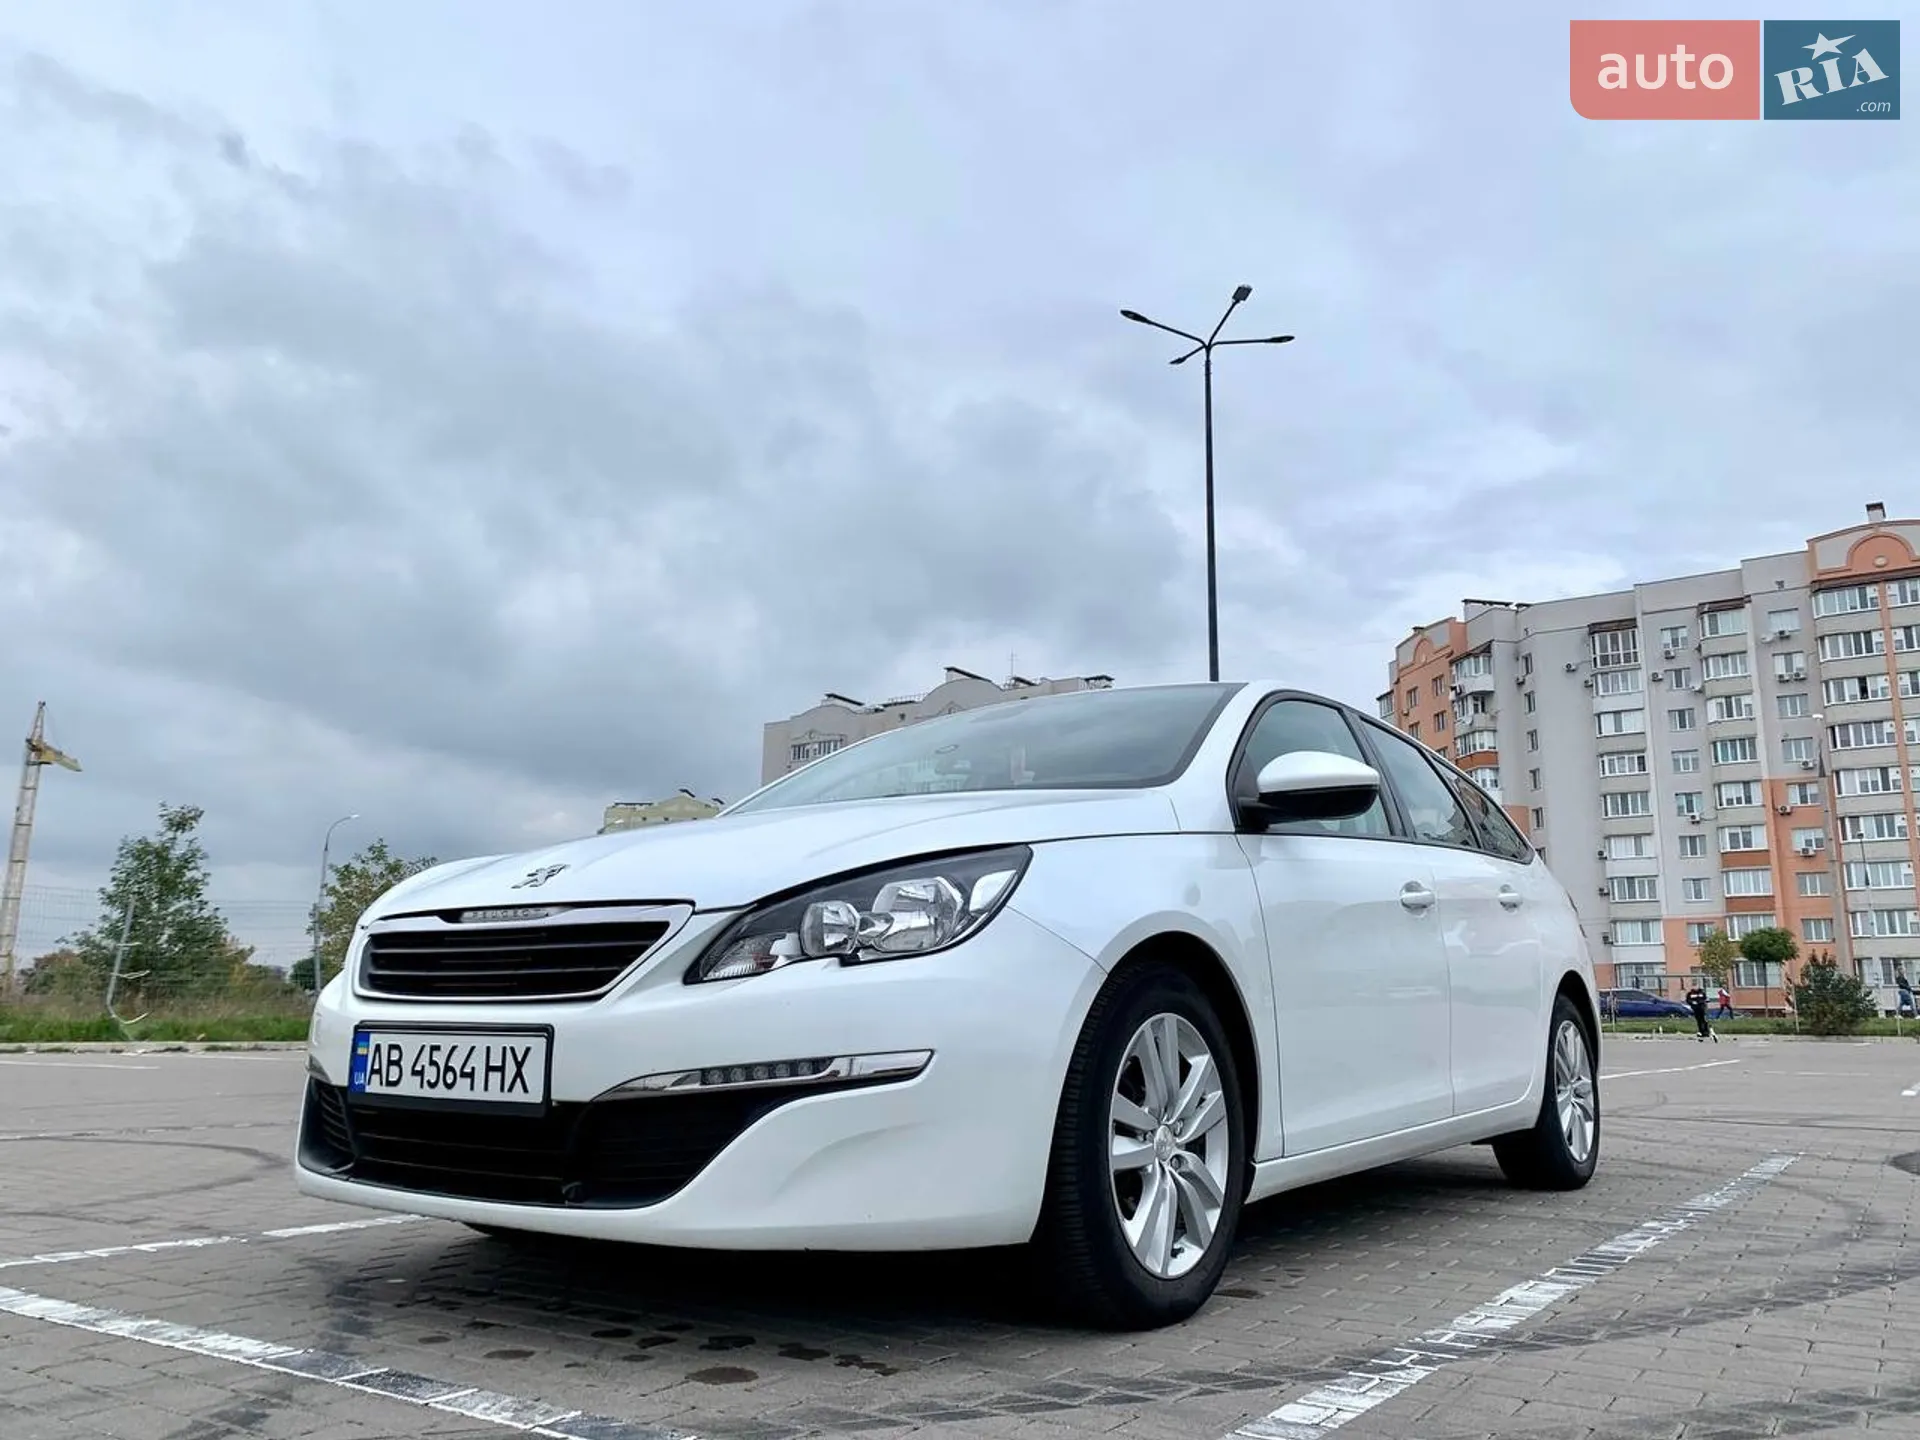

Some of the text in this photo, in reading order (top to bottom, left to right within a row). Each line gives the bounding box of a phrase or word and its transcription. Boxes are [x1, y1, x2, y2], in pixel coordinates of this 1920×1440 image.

[367, 1043, 532, 1093] AB 4564 HX
